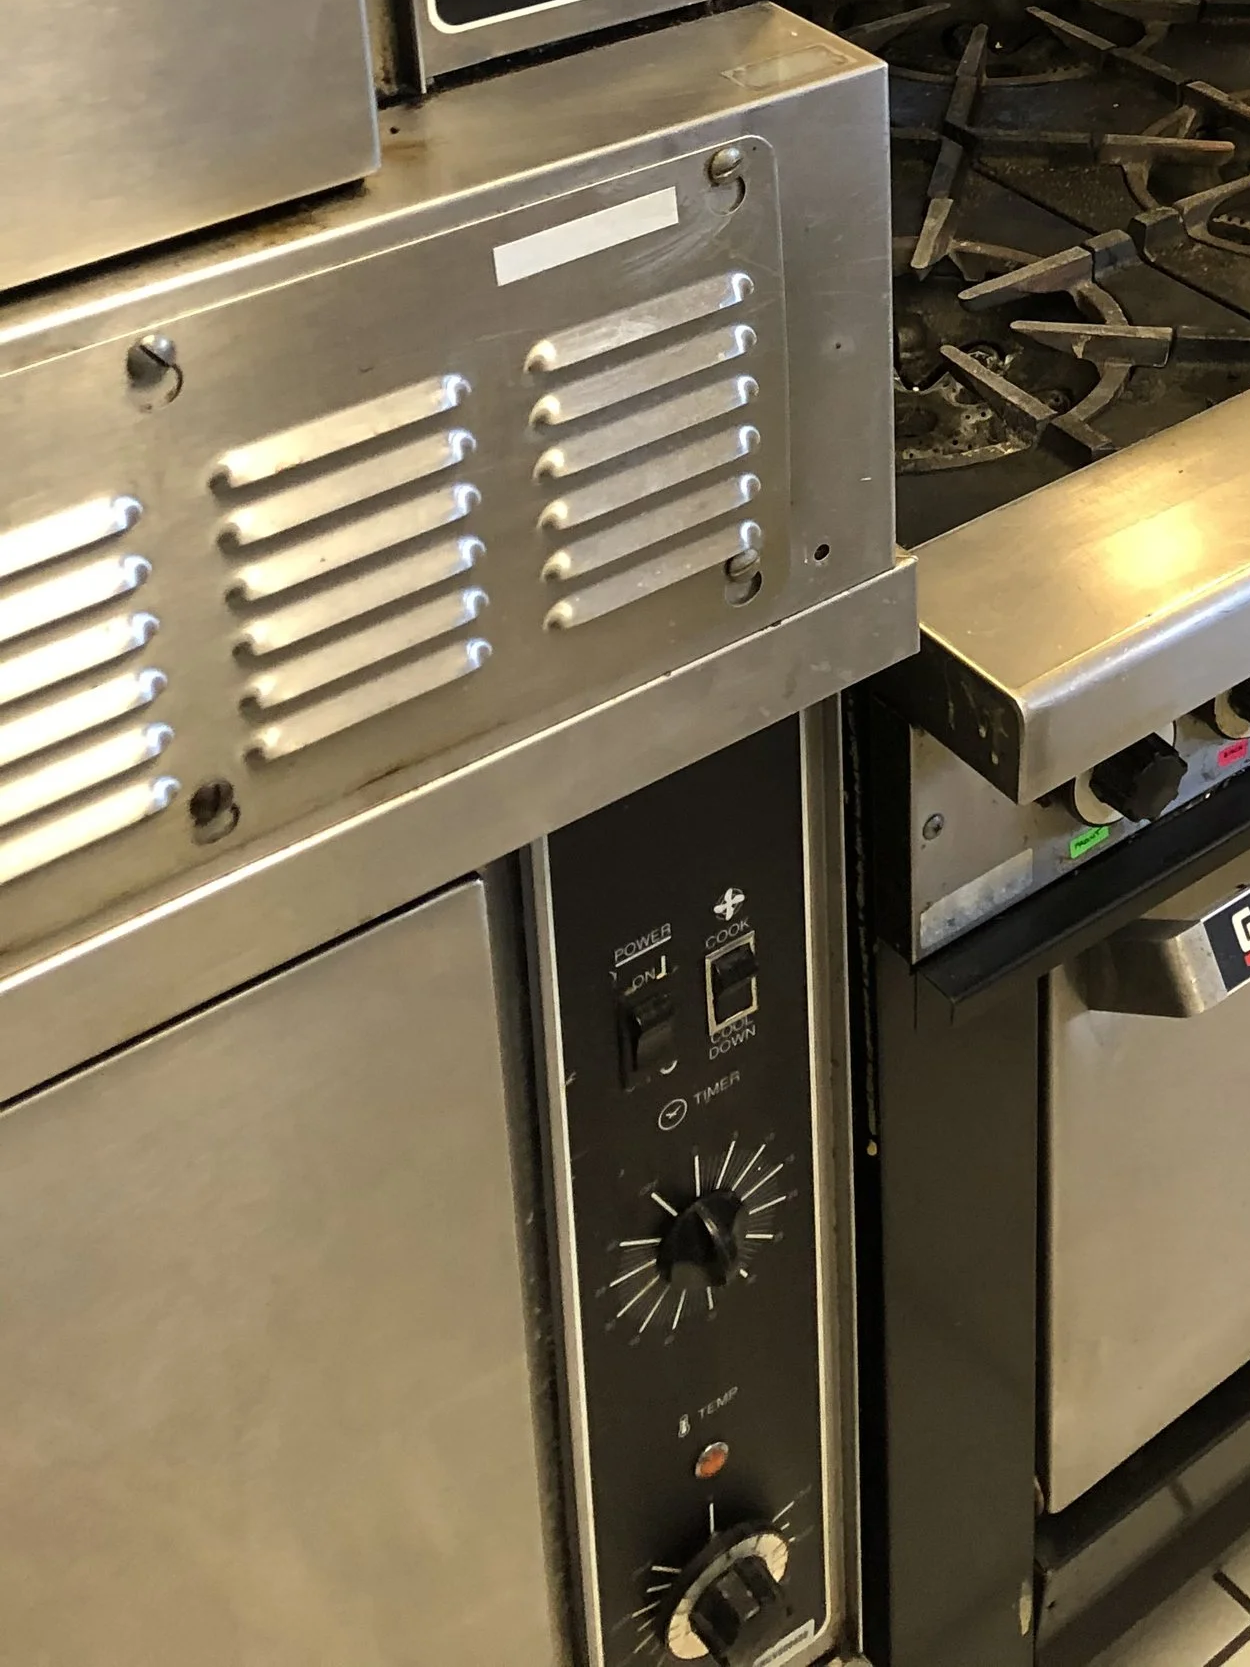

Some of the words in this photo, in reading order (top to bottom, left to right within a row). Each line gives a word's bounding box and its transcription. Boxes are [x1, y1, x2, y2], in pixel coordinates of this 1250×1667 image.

[614, 922, 672, 963] POWER
[705, 917, 751, 949] COOK
[632, 967, 657, 990] ON
[709, 1024, 756, 1061] DOWN
[710, 1015, 753, 1045] COOL
[693, 1070, 740, 1105] TIMER
[698, 1386, 738, 1420] TEMP
